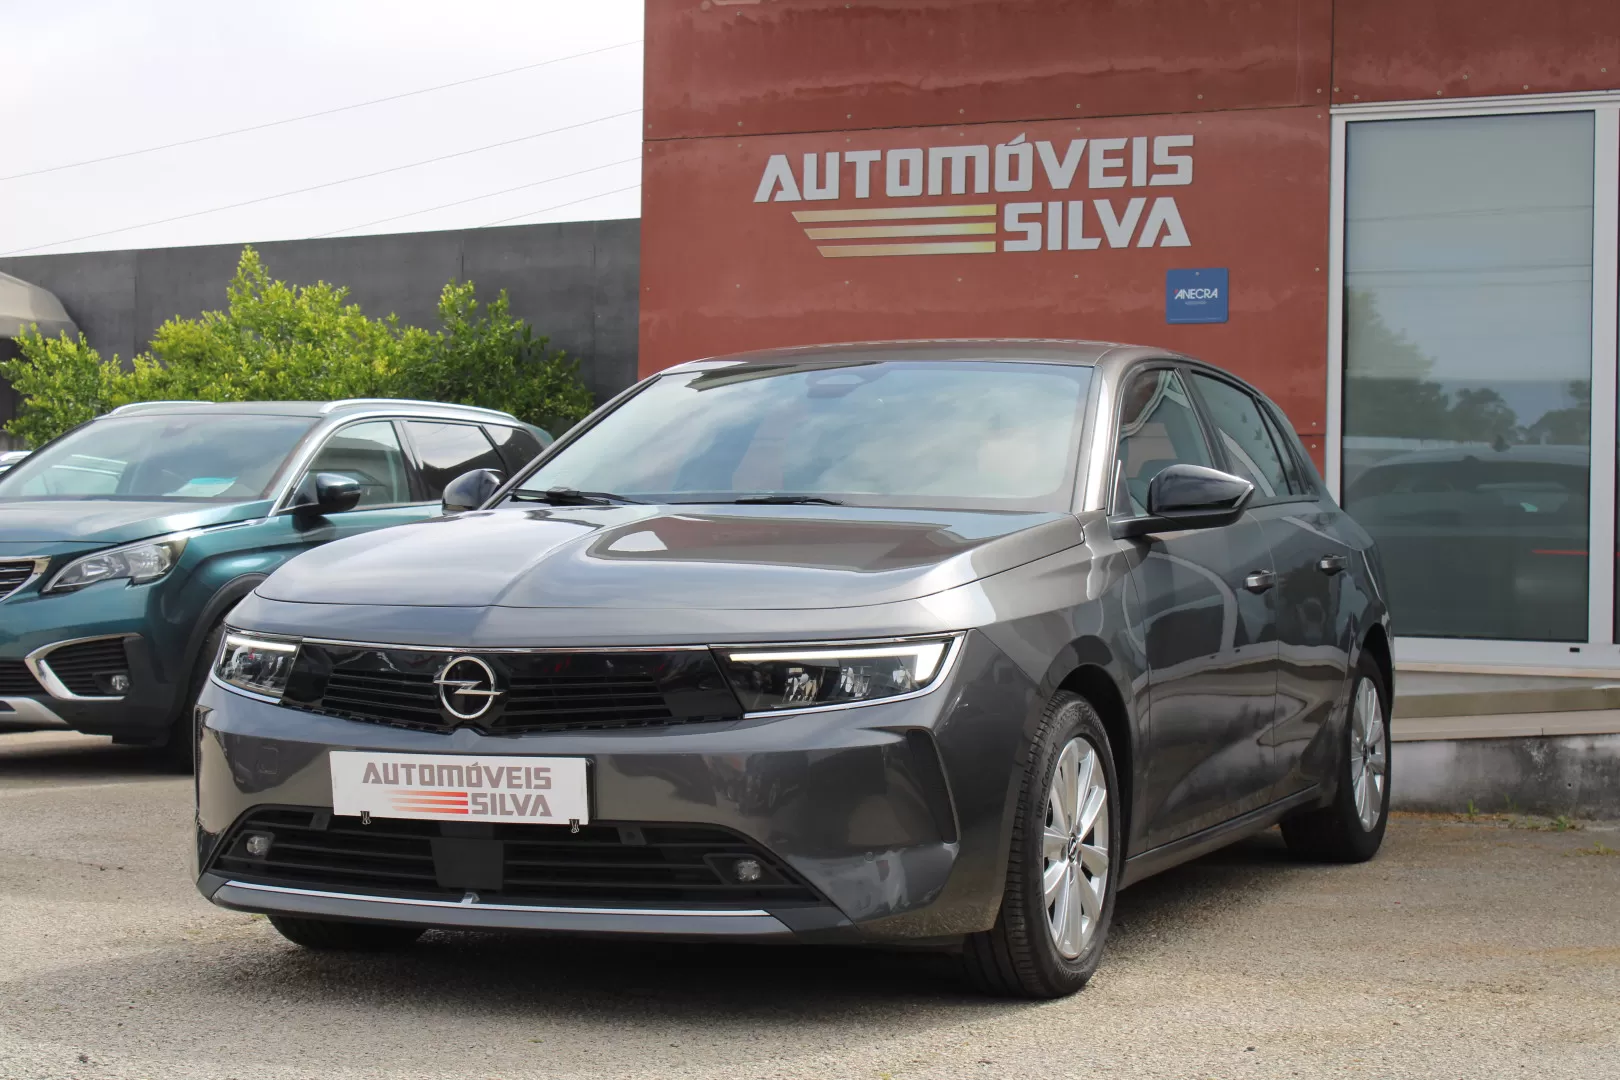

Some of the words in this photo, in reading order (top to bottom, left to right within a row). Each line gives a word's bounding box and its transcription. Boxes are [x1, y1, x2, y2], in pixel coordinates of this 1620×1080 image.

[753, 133, 1194, 202] AUTOMÓVEIS
[1003, 197, 1192, 252] SILVA
[1174, 288, 1218, 300] ANECRA
[362, 762, 552, 789] AUTOMÓVEIS
[471, 793, 552, 817] SILVA
